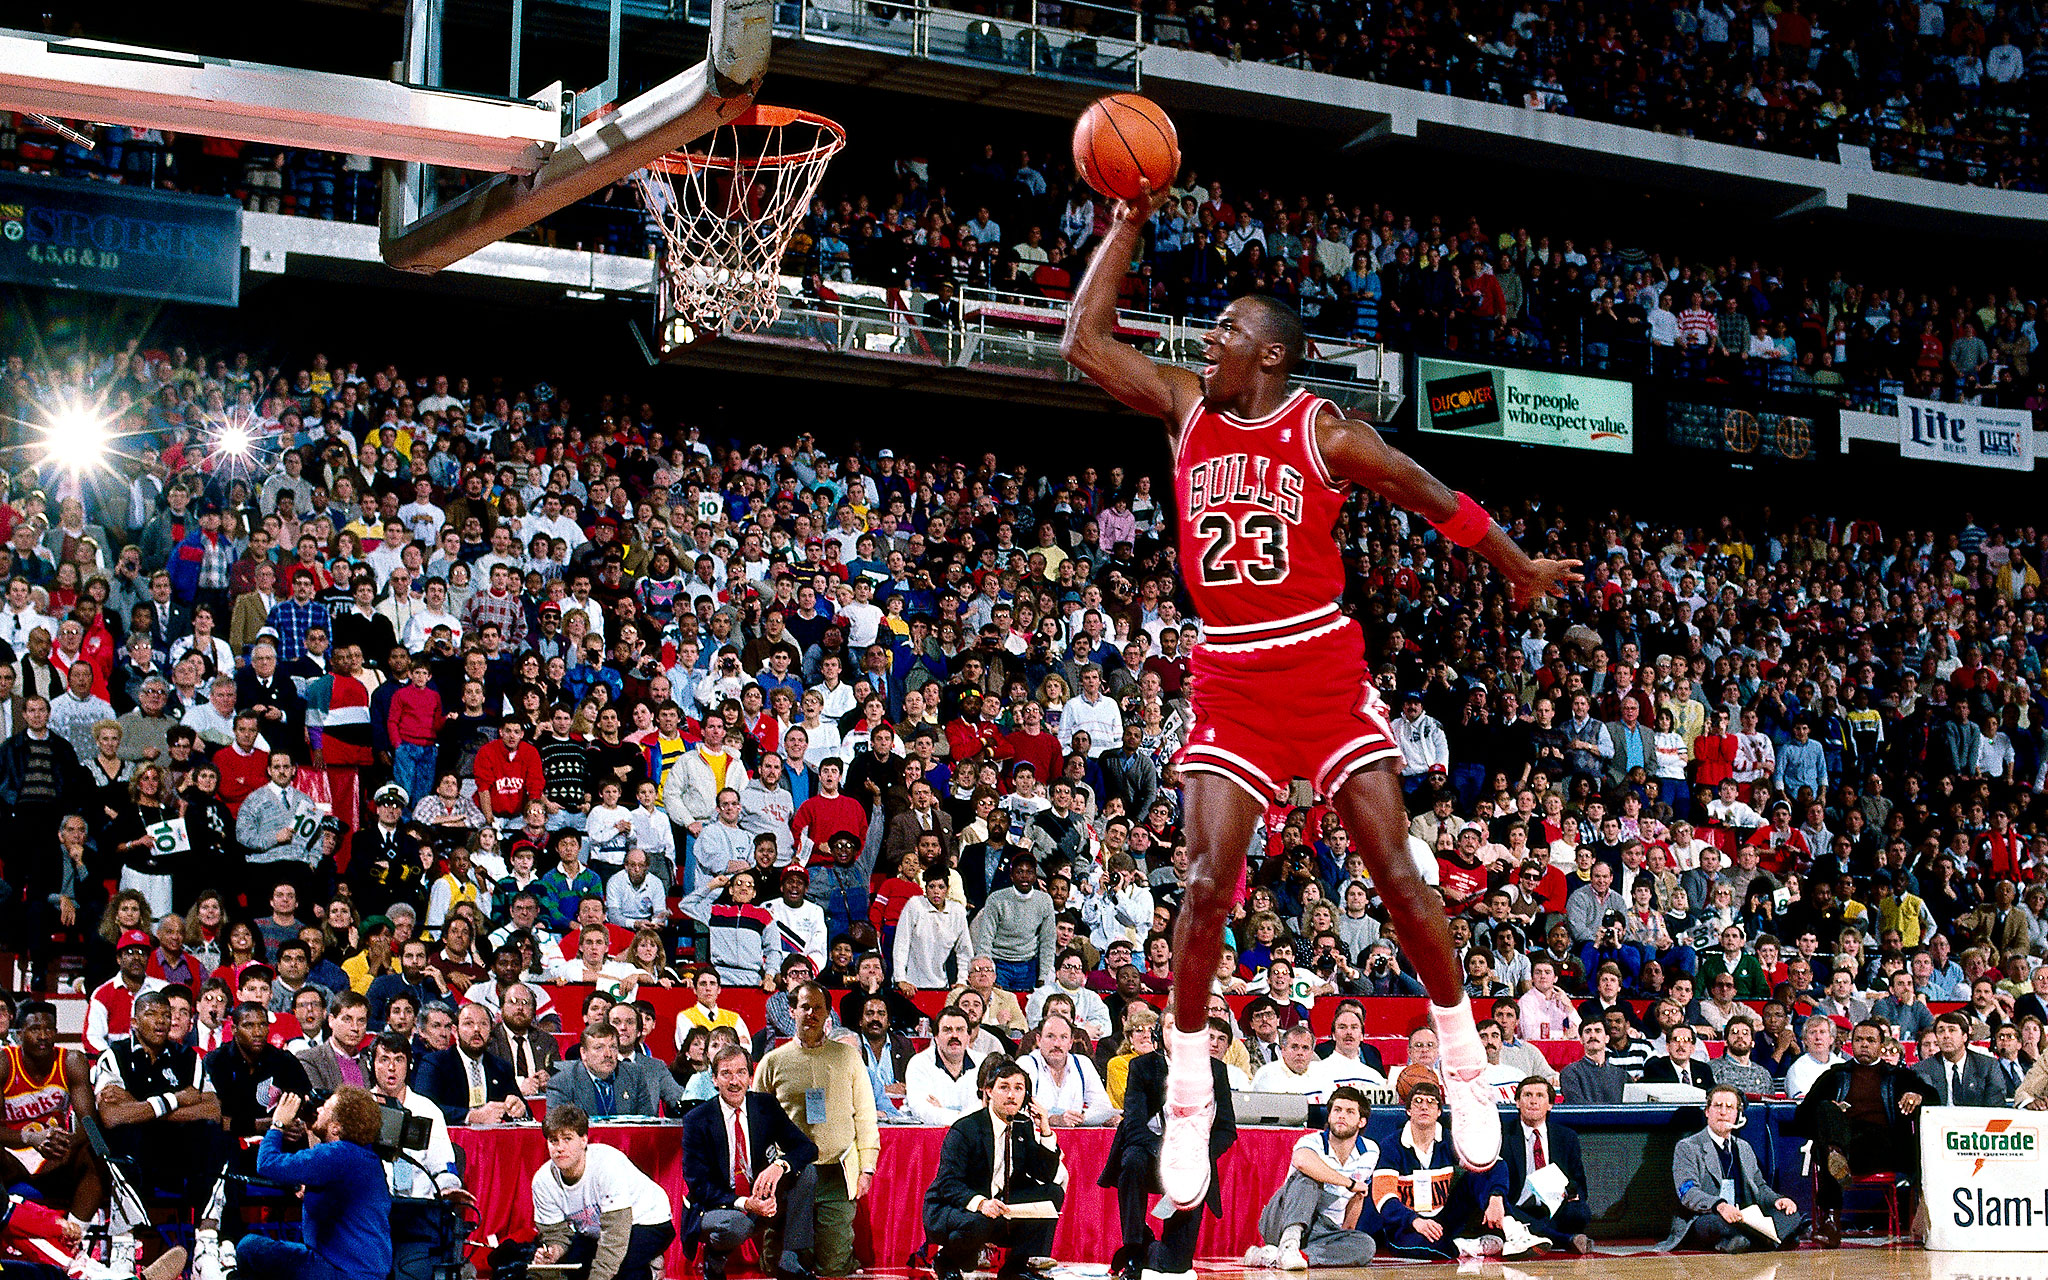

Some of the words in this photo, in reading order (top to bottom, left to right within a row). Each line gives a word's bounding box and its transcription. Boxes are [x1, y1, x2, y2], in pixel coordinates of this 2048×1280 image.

[100, 251, 120, 269] 10
[1432, 386, 1493, 412] DISCOVER
[1507, 386, 1530, 405] For
[1532, 394, 1580, 412] people
[1507, 408, 1539, 425] who
[1540, 414, 1588, 431] expect
[1590, 415, 1629, 435] value.
[1908, 405, 1966, 447] Lite
[1188, 454, 1304, 526] BULLS
[699, 501, 719, 516] 10
[1194, 511, 1290, 586] 23
[495, 776, 525, 791] BOSS
[153, 822, 177, 853] 10
[292, 813, 317, 838] 10
[1946, 1131, 2035, 1151] Gatorade
[1952, 1186, 2048, 1228] Slam-
